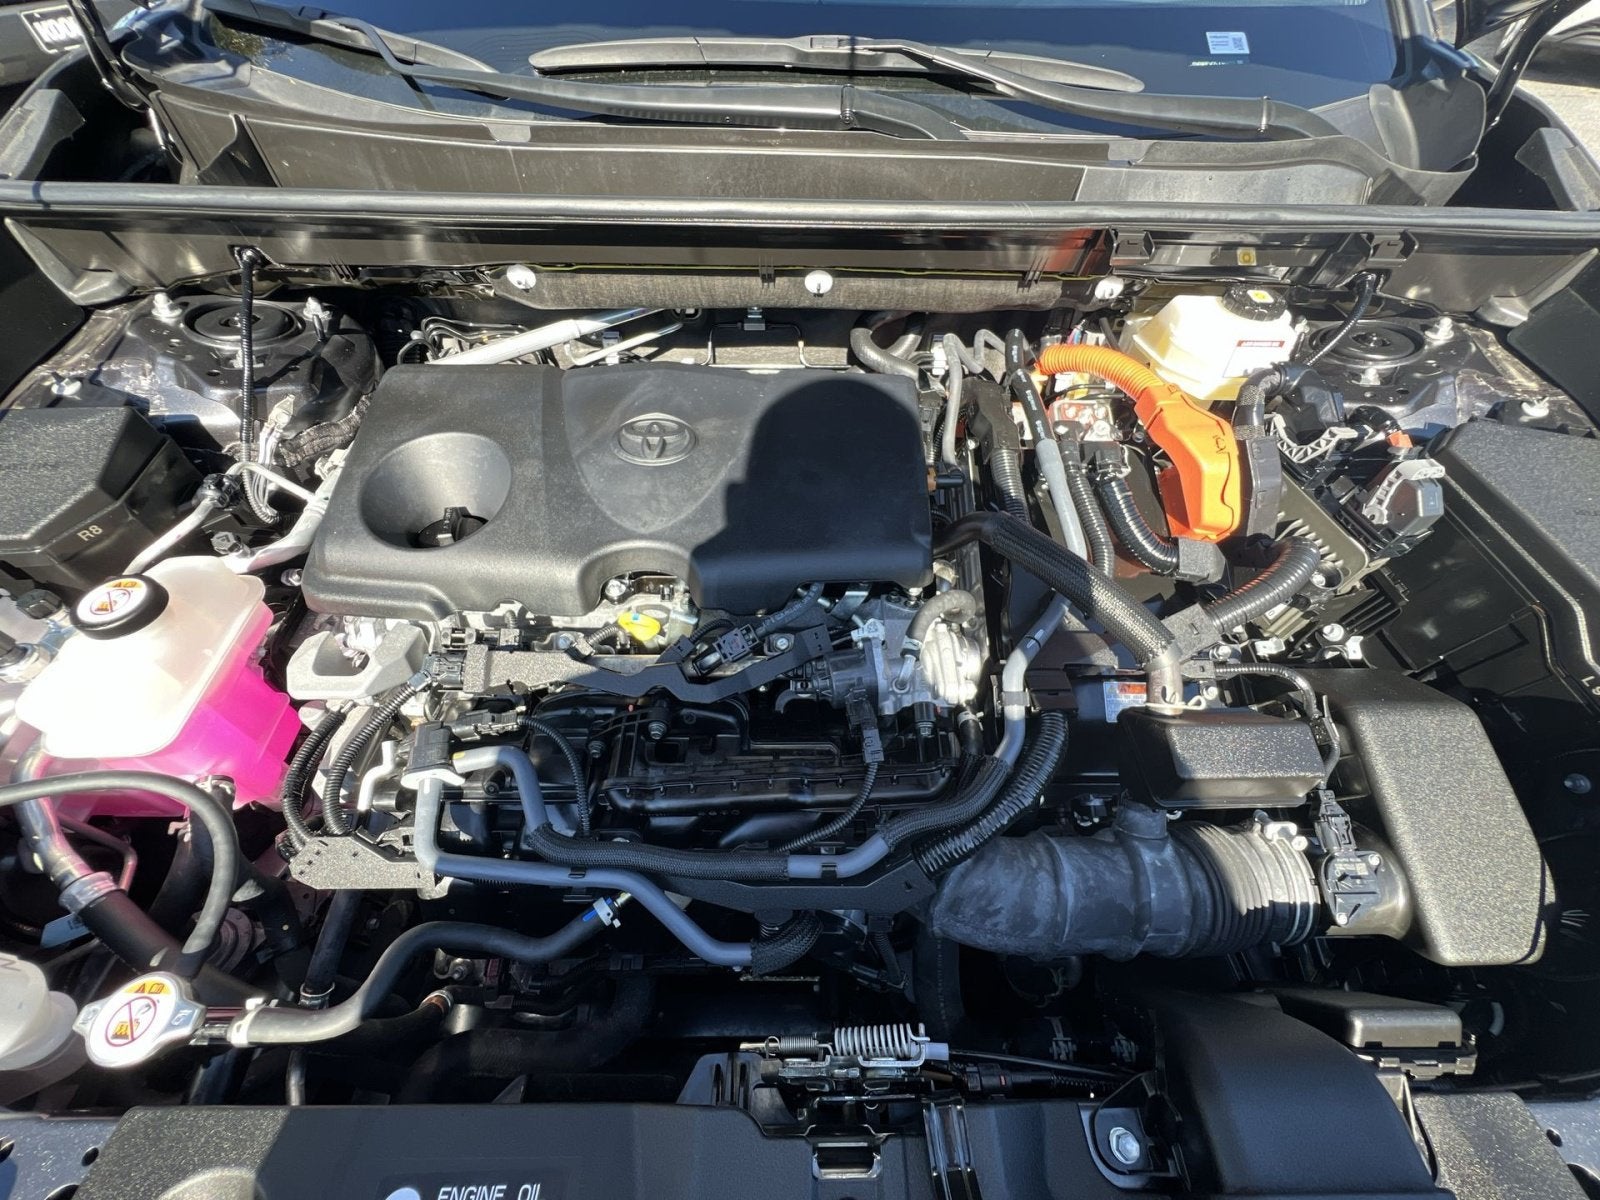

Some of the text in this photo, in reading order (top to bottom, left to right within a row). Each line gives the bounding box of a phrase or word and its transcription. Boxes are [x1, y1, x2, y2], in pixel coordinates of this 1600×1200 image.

[77, 525, 103, 541] R8
[437, 1183, 543, 1200] ENGINE OIL
